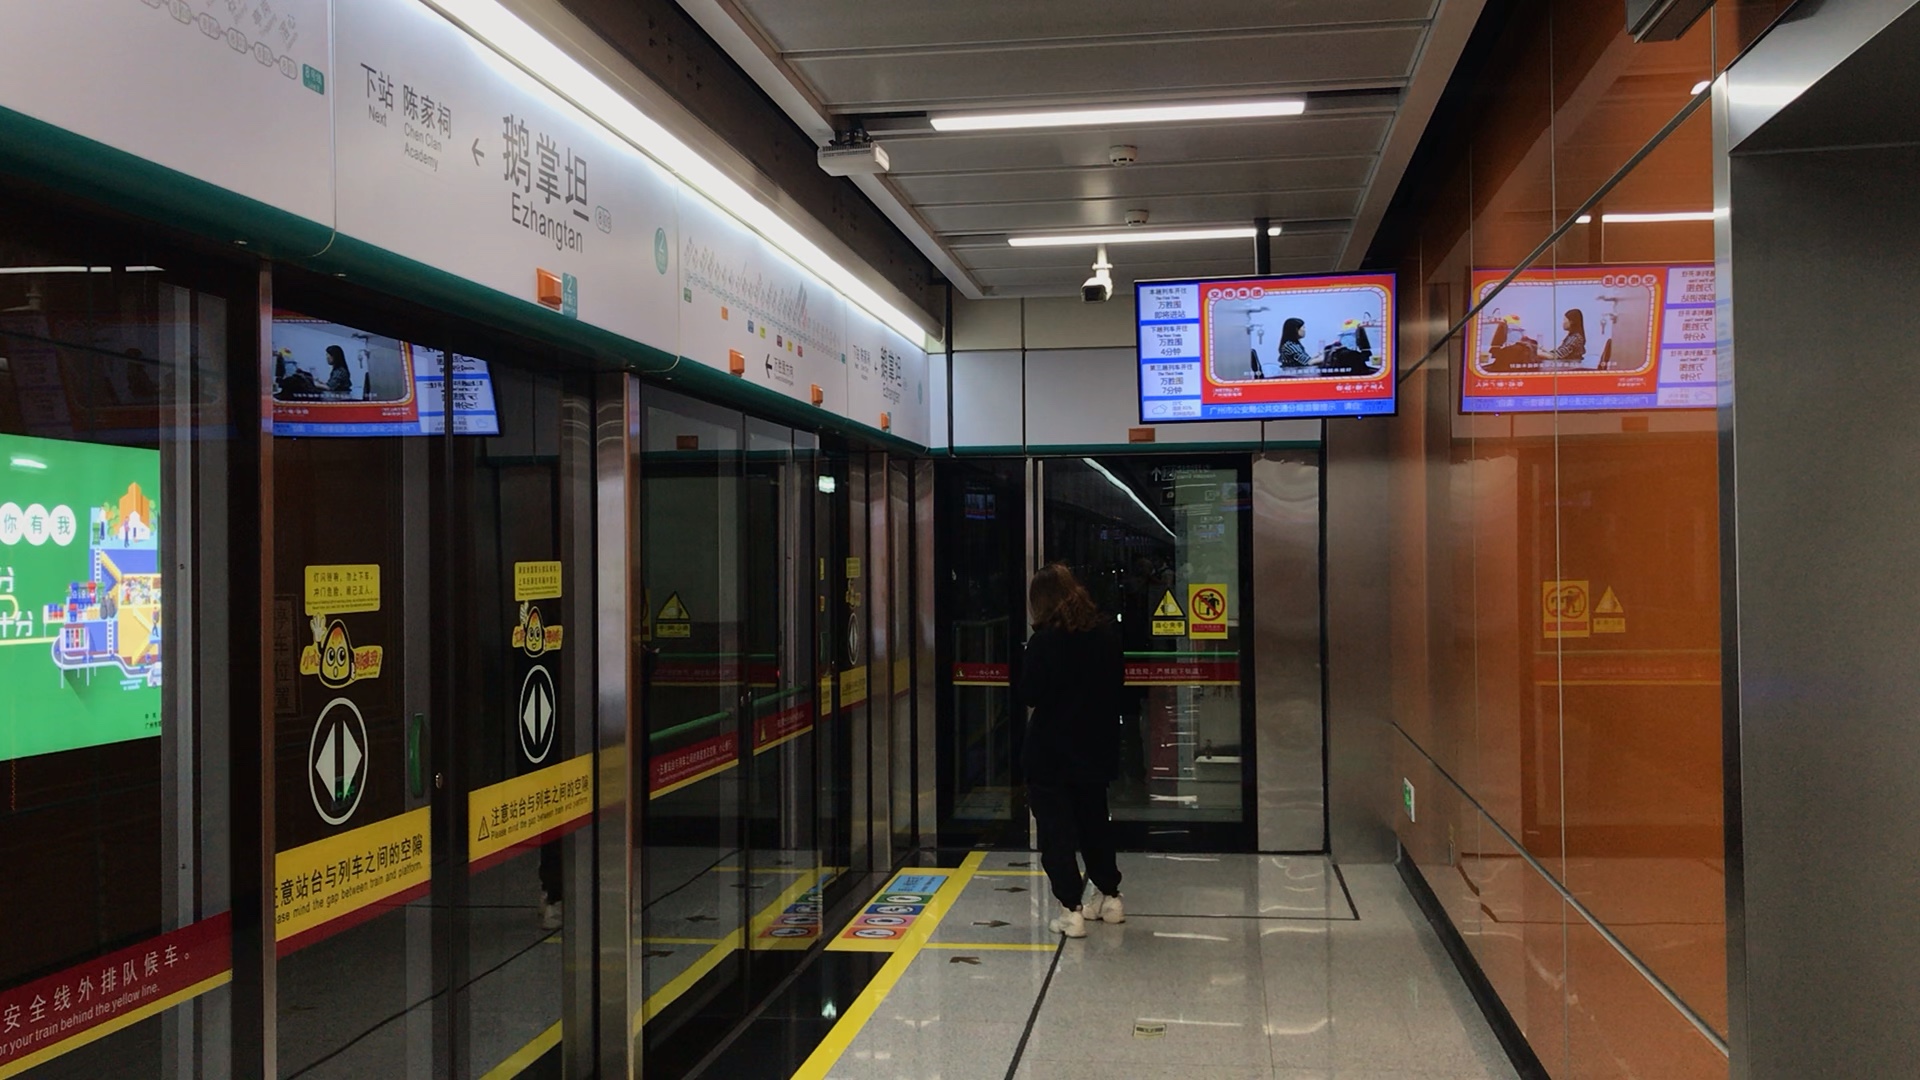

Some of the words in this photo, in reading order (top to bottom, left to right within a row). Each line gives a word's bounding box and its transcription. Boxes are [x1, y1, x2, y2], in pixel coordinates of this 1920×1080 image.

[360, 62, 393, 111] 下站
[403, 84, 451, 139] 陈家祠
[368, 104, 387, 127] Next
[404, 122, 424, 143] Chen
[425, 132, 442, 152] Clan
[404, 142, 438, 172] Academy
[502, 114, 589, 222] 鹅掌坦
[512, 192, 583, 254] Ezhangtan
[567, 275, 573, 294] 2
[1154, 310, 1186, 319] 即将进站
[1158, 300, 1182, 309] 万胜围
[1151, 325, 1188, 333] 下趟列车开往
[1159, 337, 1183, 346] 万胜围
[1161, 348, 1182, 356] 4分钟
[1160, 377, 1183, 386] 万胜围
[1162, 386, 1183, 394] 7分钟
[491, 775, 589, 827] 注意站台与列车之间的空隙
[490, 828, 507, 841] Please
[537, 810, 554, 822] between
[293, 901, 311, 917] mind
[313, 896, 324, 911] the
[326, 893, 339, 908] gap
[341, 880, 369, 900] between
[370, 876, 384, 888] train
[386, 870, 397, 883] and
[3, 944, 190, 1034] 安全线外排队候车。
[10, 1034, 34, 1056] your
[35, 1023, 58, 1041] train
[60, 1006, 94, 1031] behind
[95, 1001, 110, 1017] the
[111, 990, 141, 1013] yellow
[141, 983, 160, 998] line.
